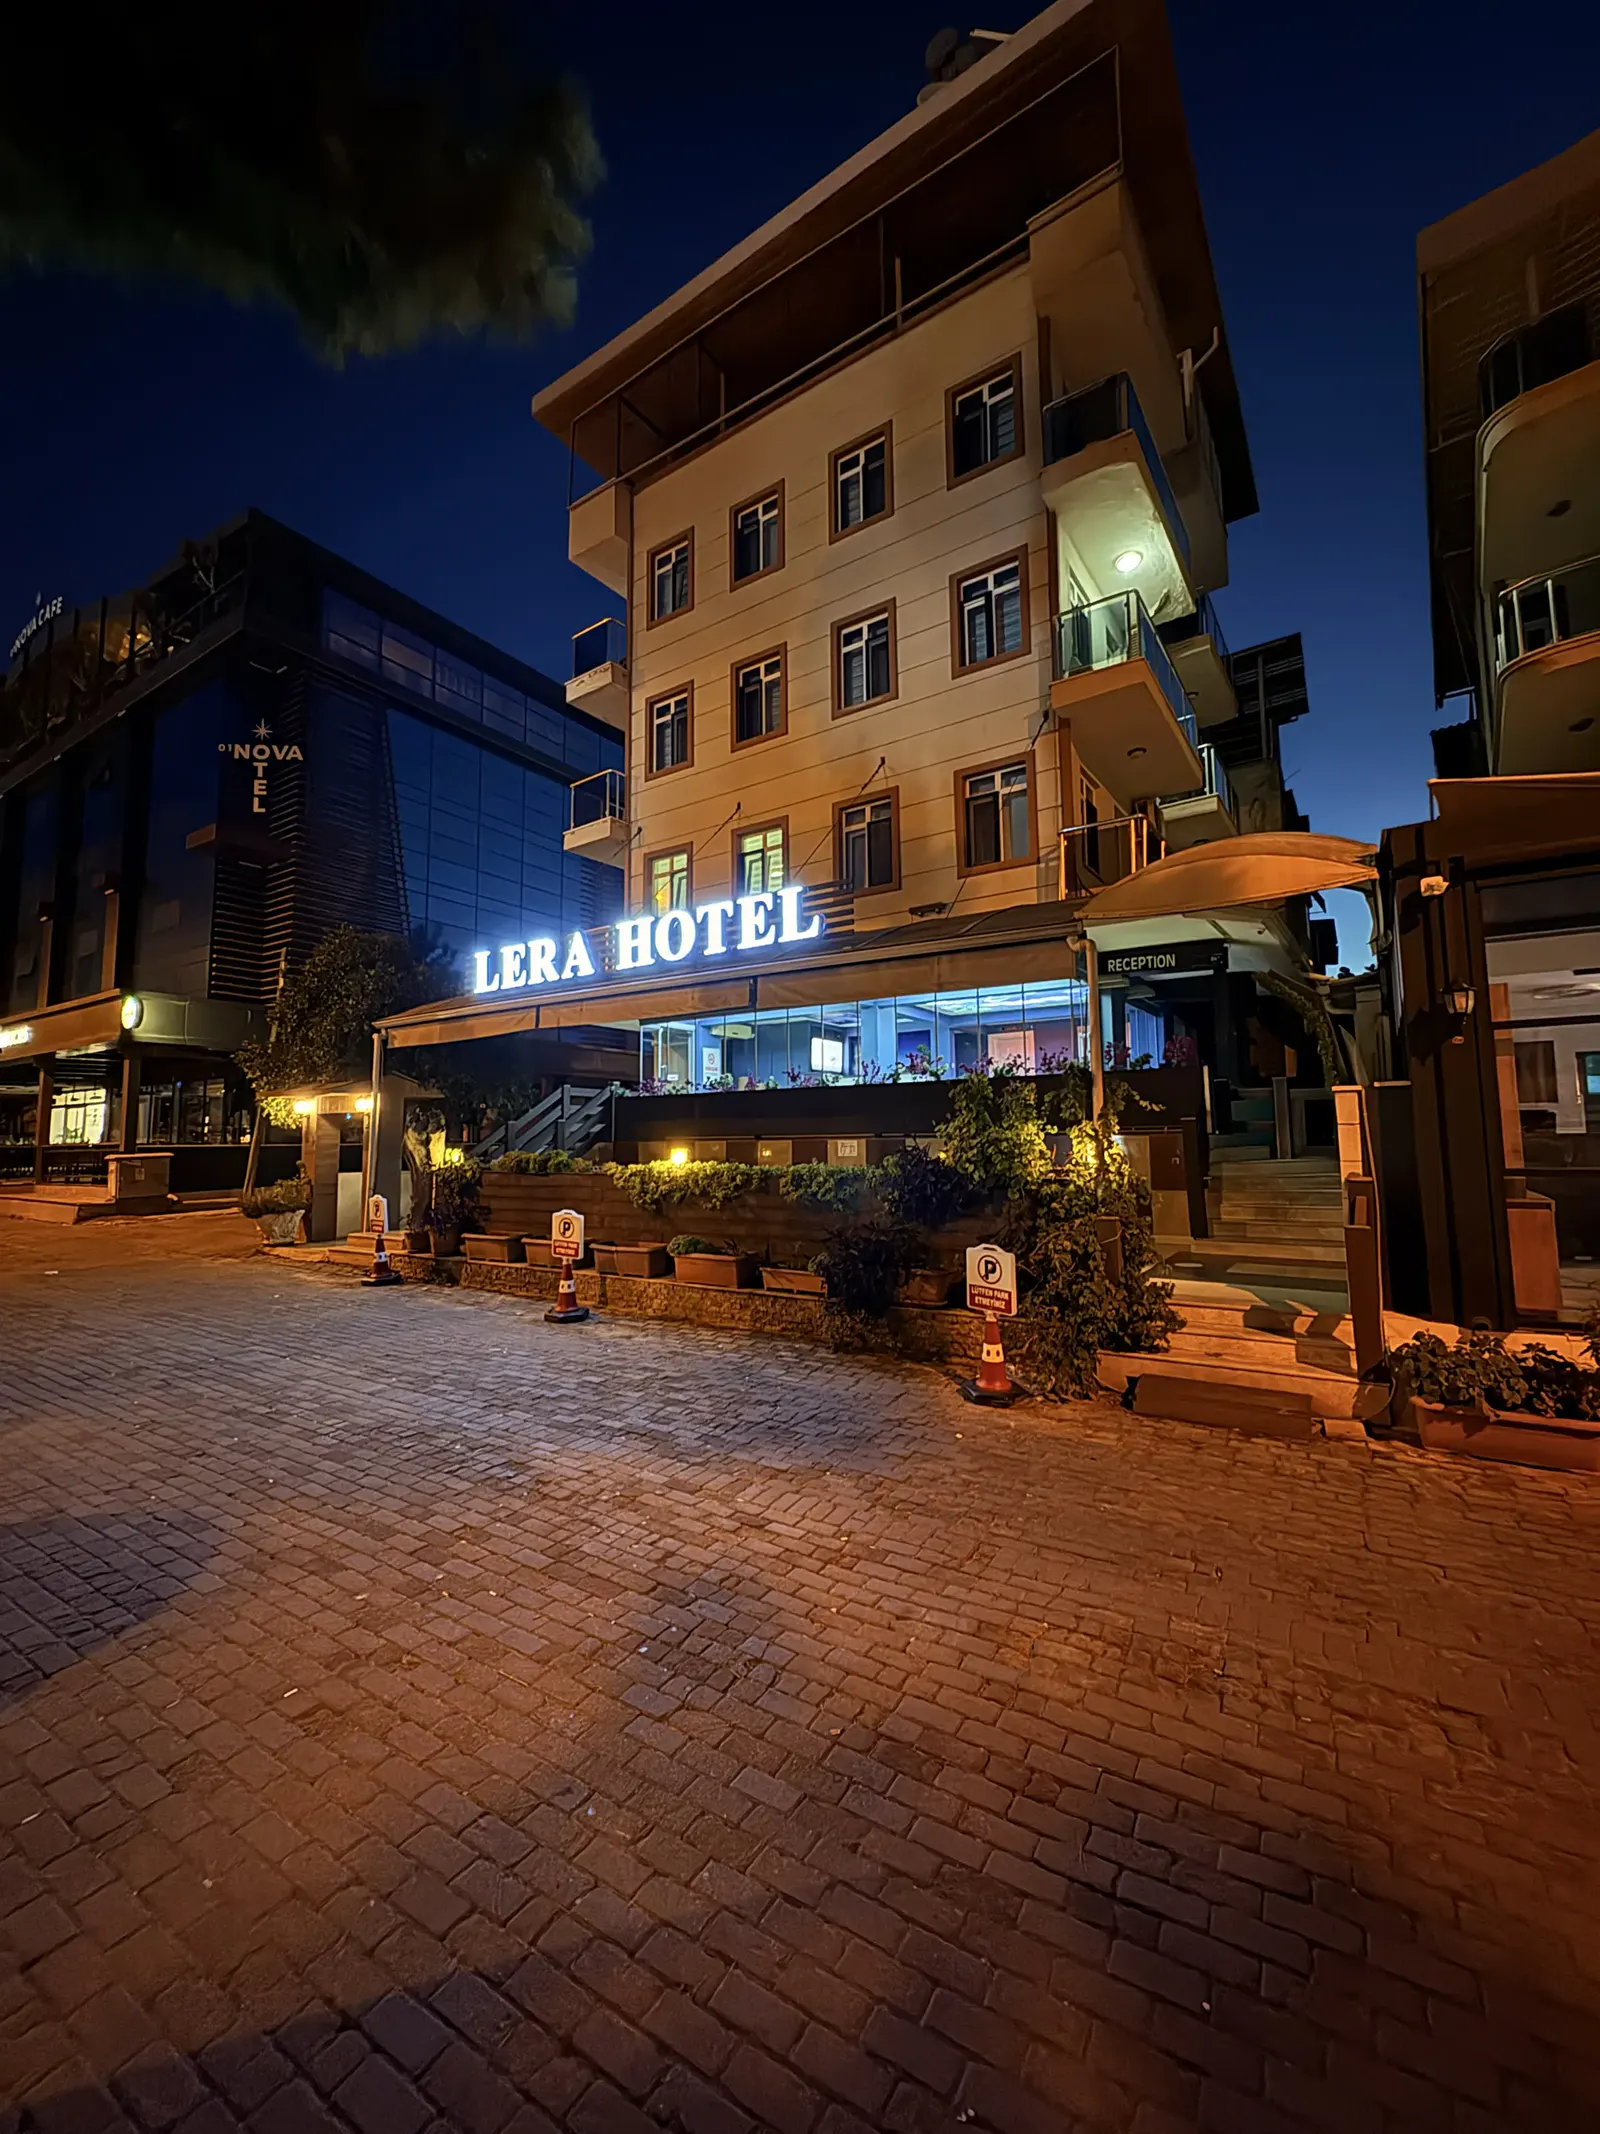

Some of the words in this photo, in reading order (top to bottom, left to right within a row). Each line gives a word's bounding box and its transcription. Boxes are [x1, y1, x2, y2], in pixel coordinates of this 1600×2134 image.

[38, 596, 63, 626] CAFE
[473, 930, 595, 995] LERA
[613, 884, 825, 971] HOTEL
[1107, 953, 1176, 973] RECEPTION
[984, 1259, 997, 1280] P
[994, 1290, 1009, 1300] PARK
